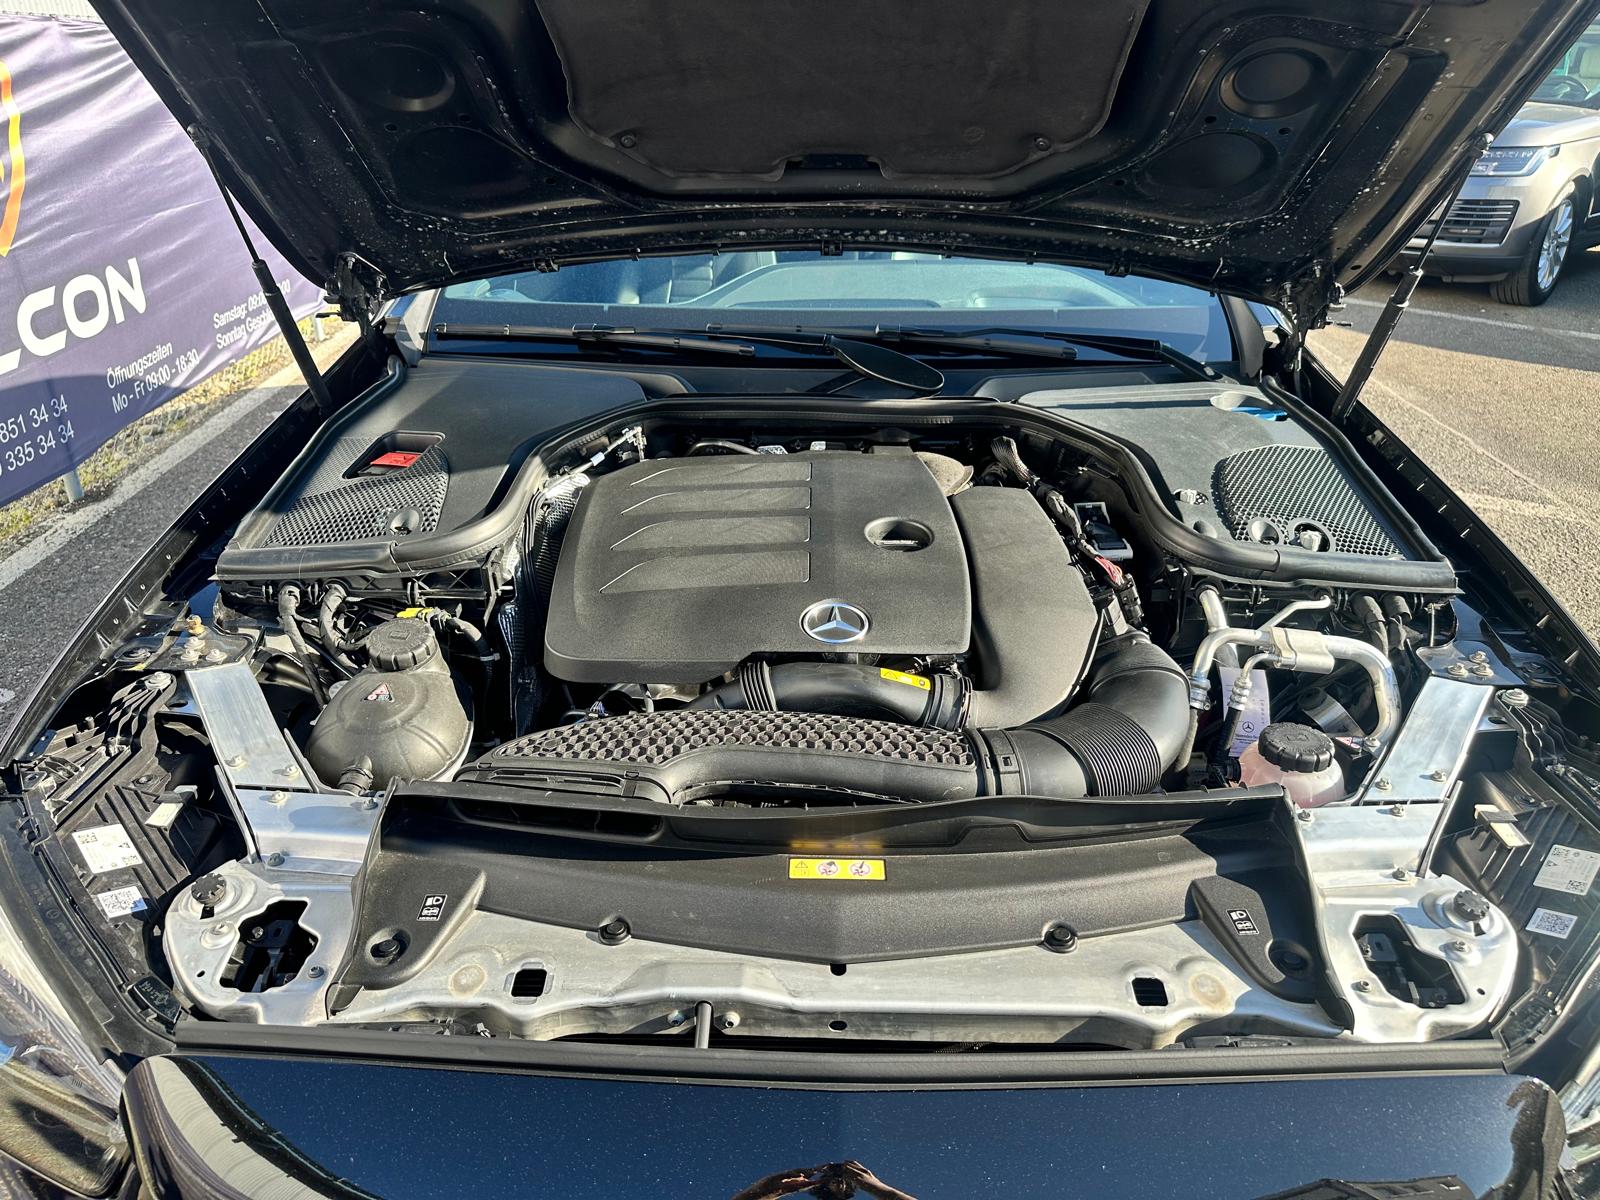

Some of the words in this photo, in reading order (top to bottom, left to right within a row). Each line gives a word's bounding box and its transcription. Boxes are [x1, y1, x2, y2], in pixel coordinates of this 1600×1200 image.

[215, 324, 248, 350] Sonntag
[106, 342, 173, 389] Öffnungszeiten
[111, 393, 129, 414] Mo
[134, 381, 145, 400] Fr
[145, 364, 171, 392] 09:00
[175, 348, 200, 374] 18:30
[0, 413, 26, 443] 851
[29, 403, 49, 428] 34
[50, 394, 68, 418] 34
[5, 440, 35, 471] 335
[37, 430, 56, 455] 34
[58, 420, 75, 444] 34
